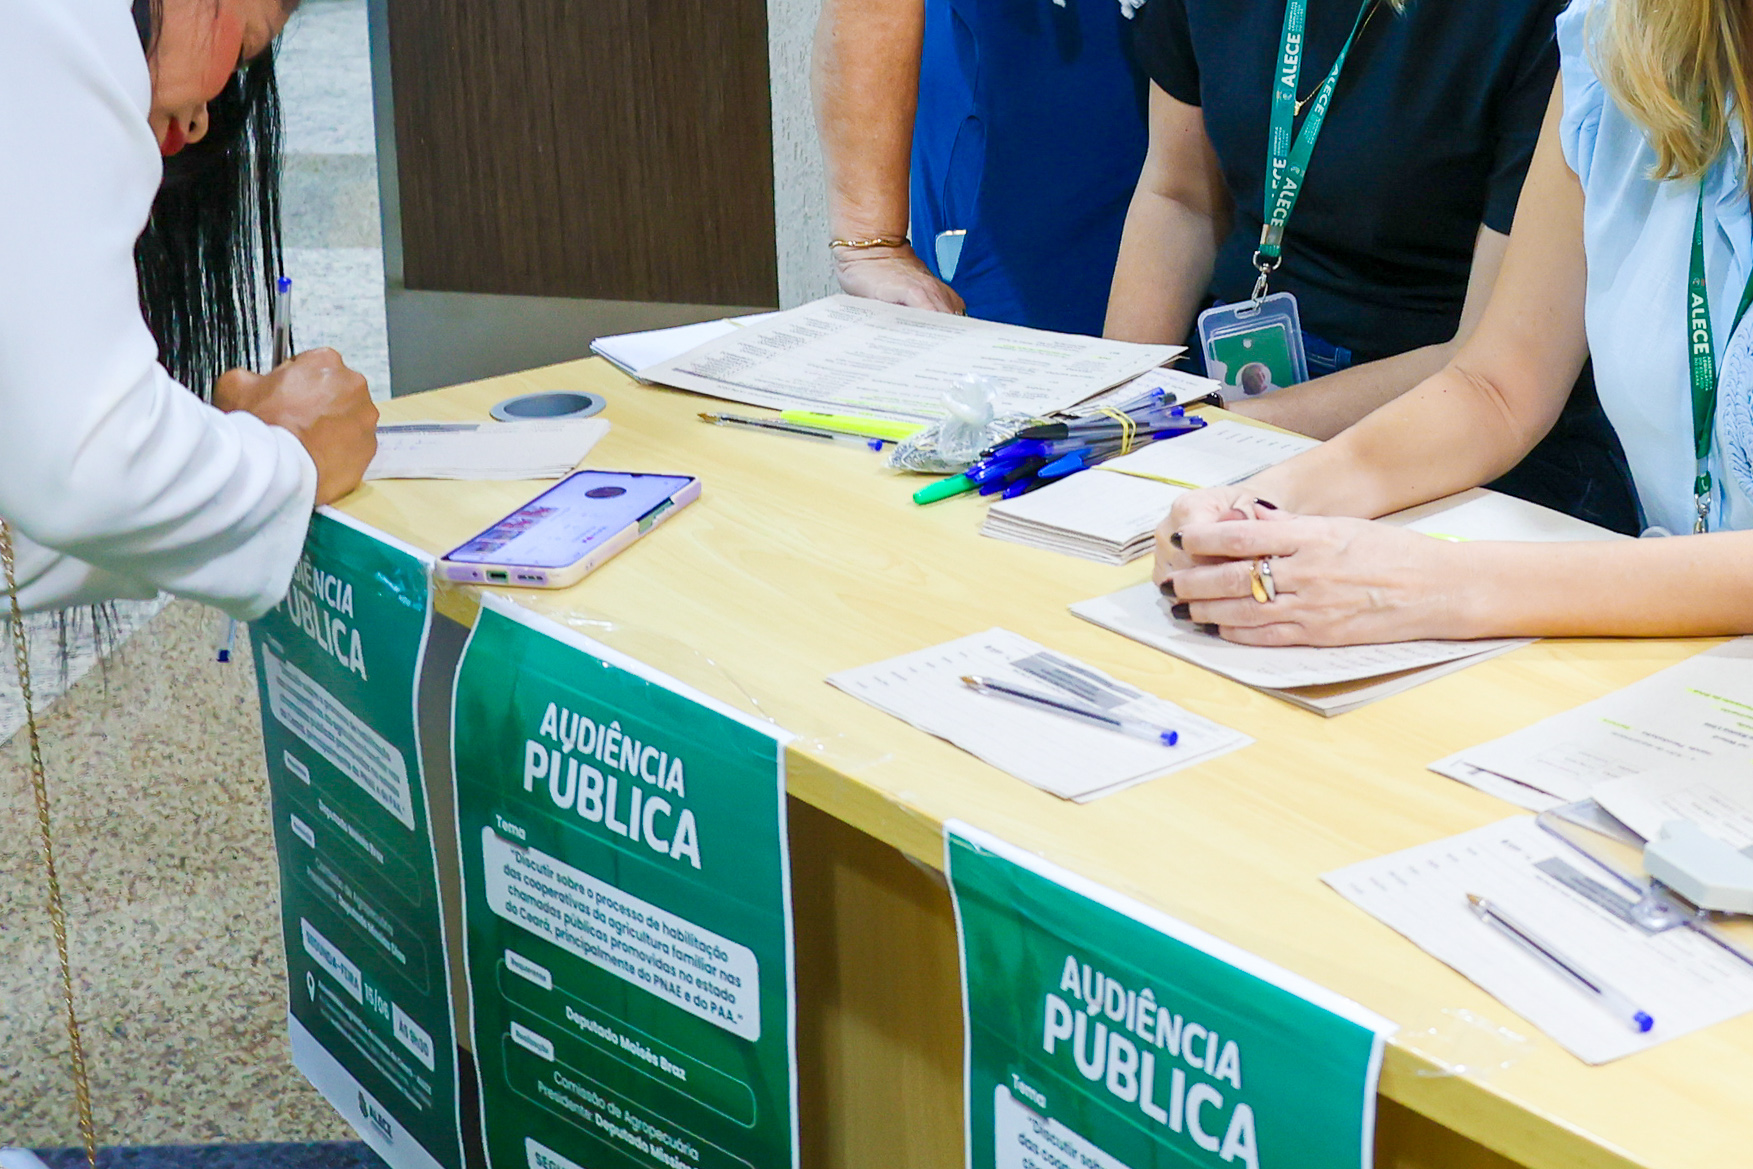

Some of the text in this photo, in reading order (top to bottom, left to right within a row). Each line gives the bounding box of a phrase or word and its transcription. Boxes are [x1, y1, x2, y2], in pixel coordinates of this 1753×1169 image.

[1281, 32, 1301, 88] ALECE
[1314, 63, 1338, 116] ALECE
[1271, 176, 1298, 227] ALECE
[1691, 292, 1710, 355] ALECE
[294, 553, 354, 619] DIÊNCIA
[276, 585, 368, 682] ÚBLICA
[539, 702, 685, 798] AUDIÊNCIA
[496, 814, 527, 840] Tema
[523, 737, 702, 870] PÚBLICA
[504, 864, 742, 988] das cooperativas da agricultura familiar nas
[505, 900, 518, 916] do
[520, 907, 553, 936] Ceará,
[554, 926, 636, 975] principalmente
[637, 965, 652, 982] do
[653, 973, 682, 1000] PNAE
[684, 991, 692, 1003] e
[693, 994, 709, 1011] do
[508, 884, 736, 1005] chamadas públicas promovidas no estado
[556, 871, 585, 893] sobre
[587, 888, 594, 898] o
[595, 891, 644, 924] processo
[646, 913, 660, 930] de
[662, 920, 729, 964] habilitação
[565, 1005, 687, 1082] Deputado Moisés Braz
[1059, 955, 1242, 1090] AUDIÊNCIA
[553, 1070, 700, 1162] Comissão de Agropecuária
[1011, 1073, 1047, 1109] Tema
[1043, 992, 1261, 1169] PÚBLICA
[595, 1113, 649, 1154] Deputado
